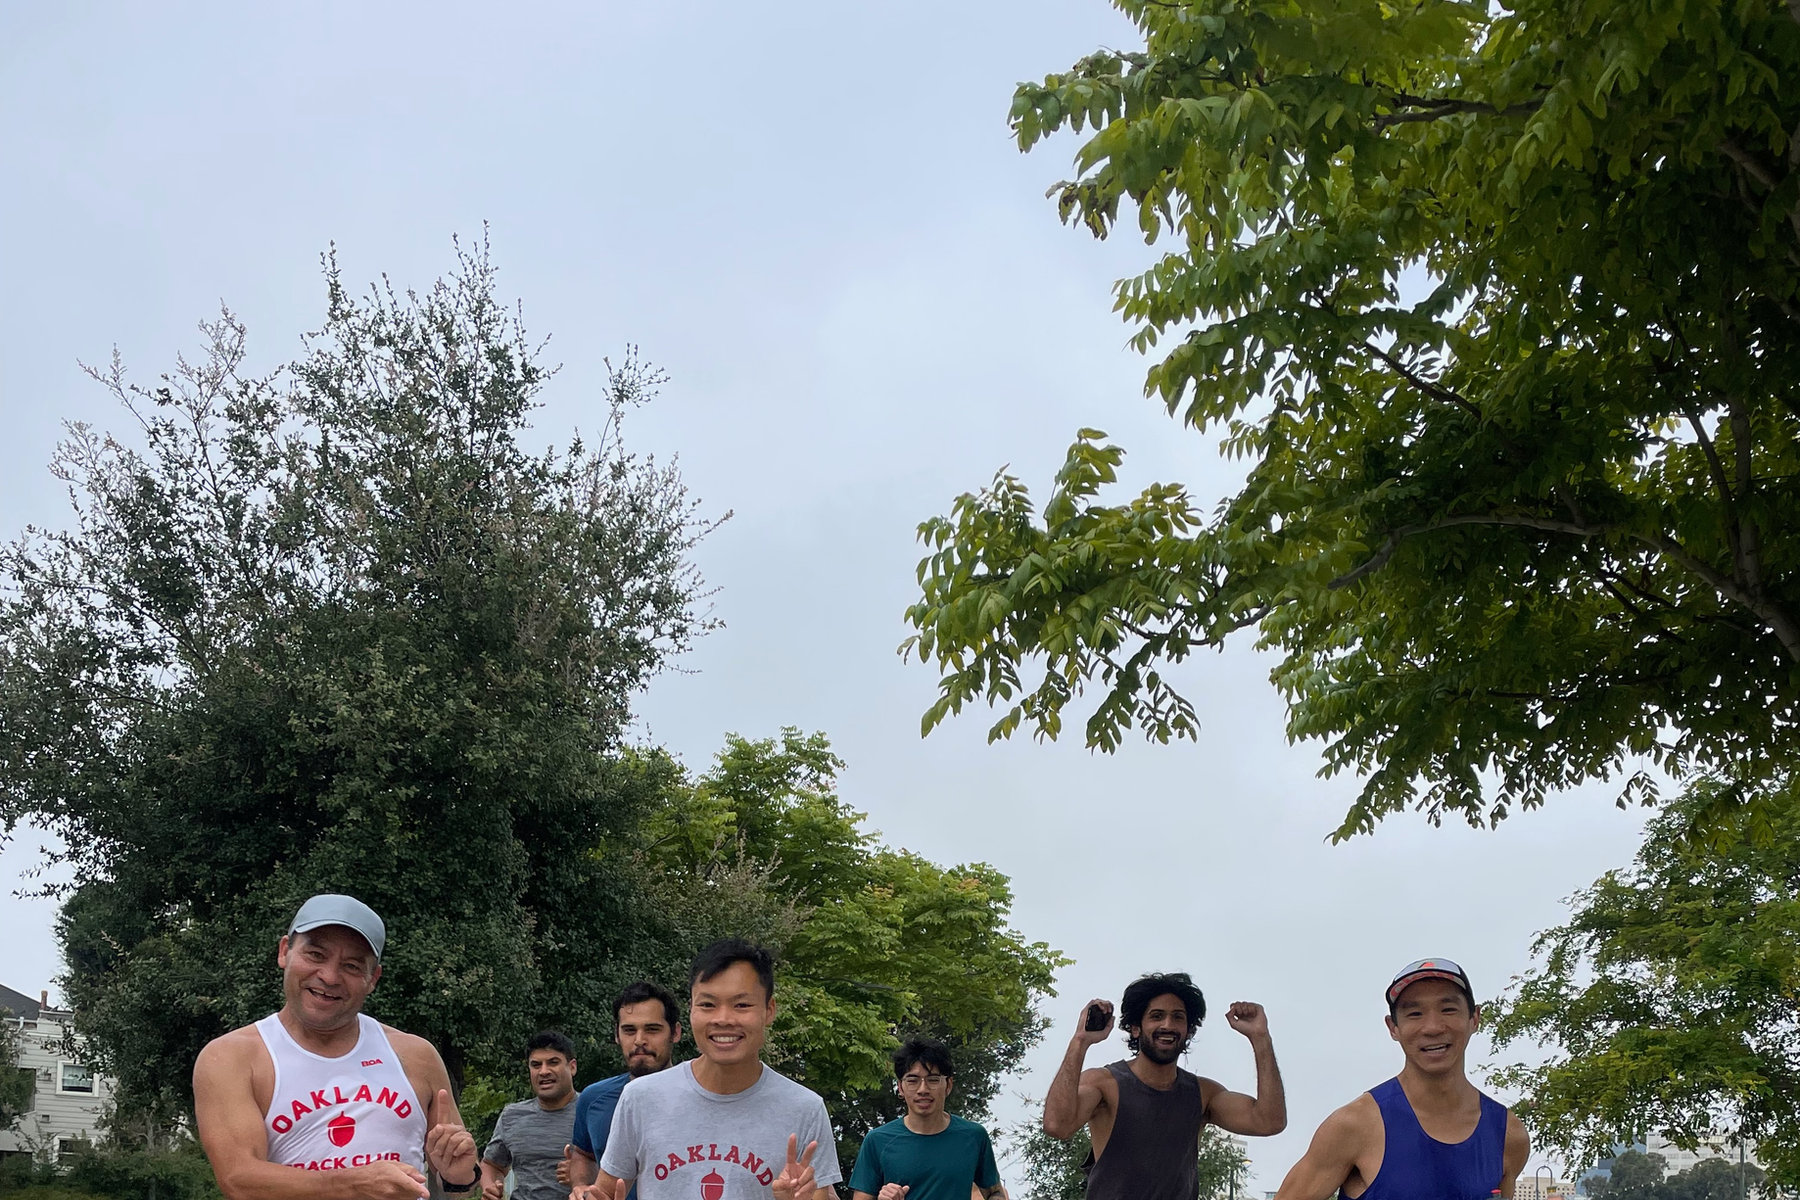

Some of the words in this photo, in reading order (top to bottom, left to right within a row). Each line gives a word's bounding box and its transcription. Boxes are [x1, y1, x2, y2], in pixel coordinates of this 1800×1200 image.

[271, 1084, 412, 1134] OAKLAND
[286, 1156, 347, 1171] ACK
[654, 1143, 774, 1187] OAKLAND
